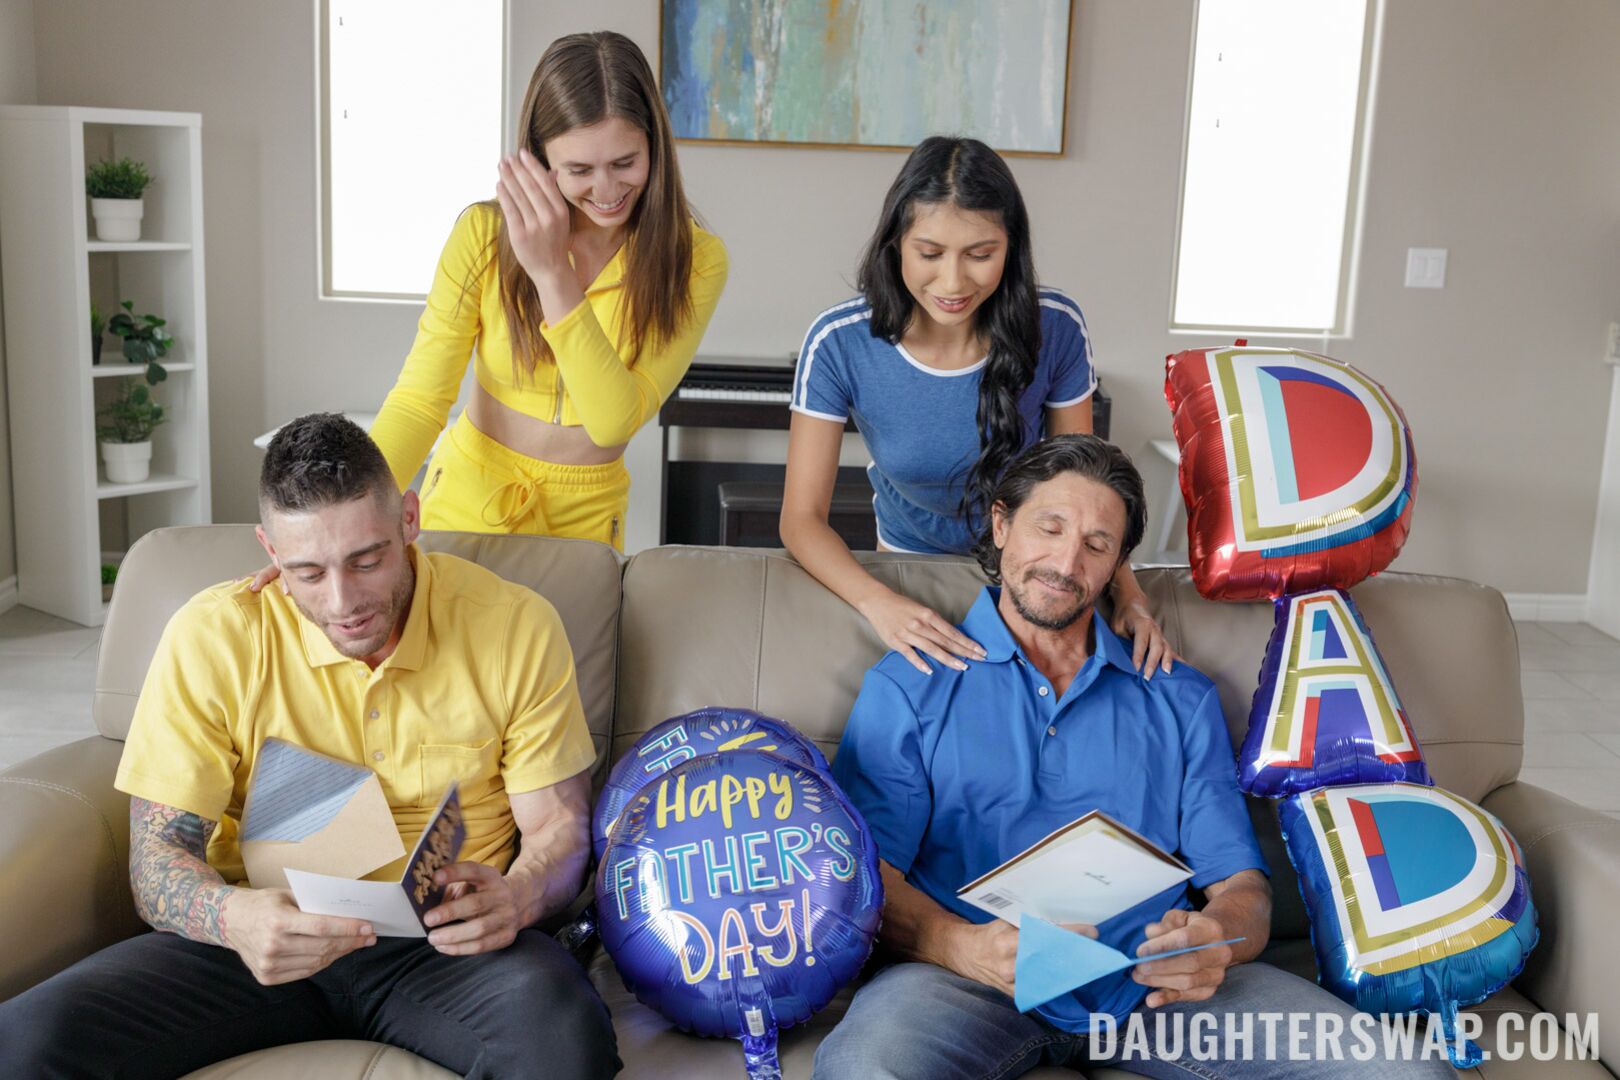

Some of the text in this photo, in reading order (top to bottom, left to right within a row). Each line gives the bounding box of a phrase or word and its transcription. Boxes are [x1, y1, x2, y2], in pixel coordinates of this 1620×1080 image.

[1206, 349, 1530, 977] DAD
[656, 772, 793, 829] Happy
[614, 823, 857, 920] FATHER'S
[652, 888, 816, 985] DAY!
